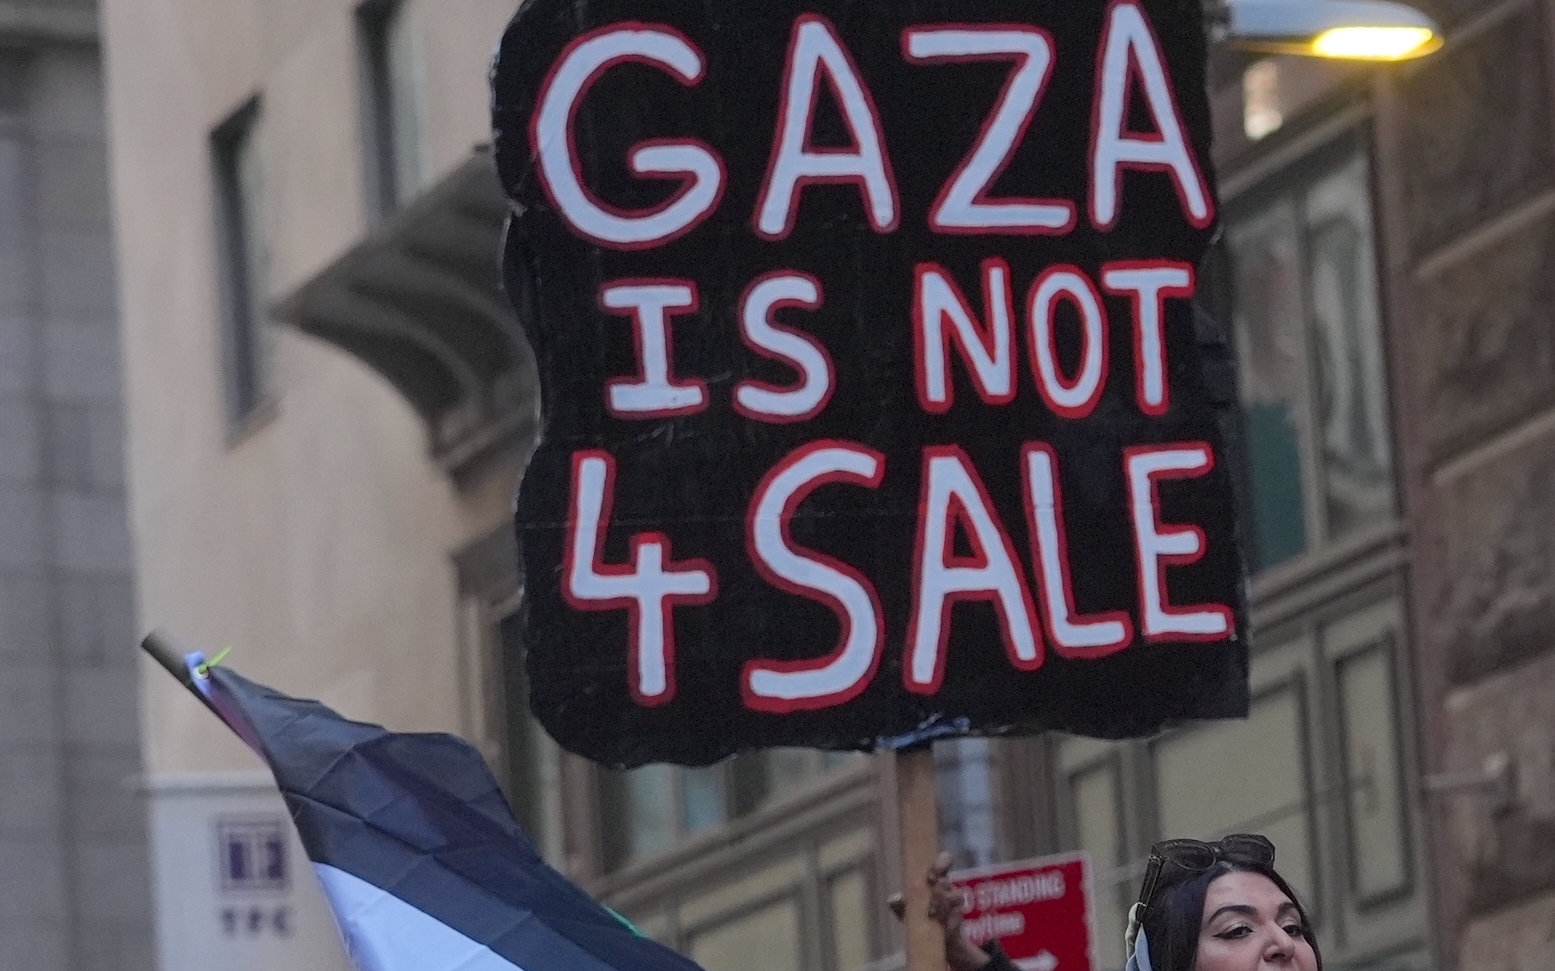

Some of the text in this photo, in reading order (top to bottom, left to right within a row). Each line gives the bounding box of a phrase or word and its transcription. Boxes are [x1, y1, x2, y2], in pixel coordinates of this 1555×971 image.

[533, 0, 1213, 249] GAZA
[602, 260, 1193, 419] IS NOT
[565, 440, 1232, 712] 4 SALE
[975, 870, 1065, 910] STANDING
